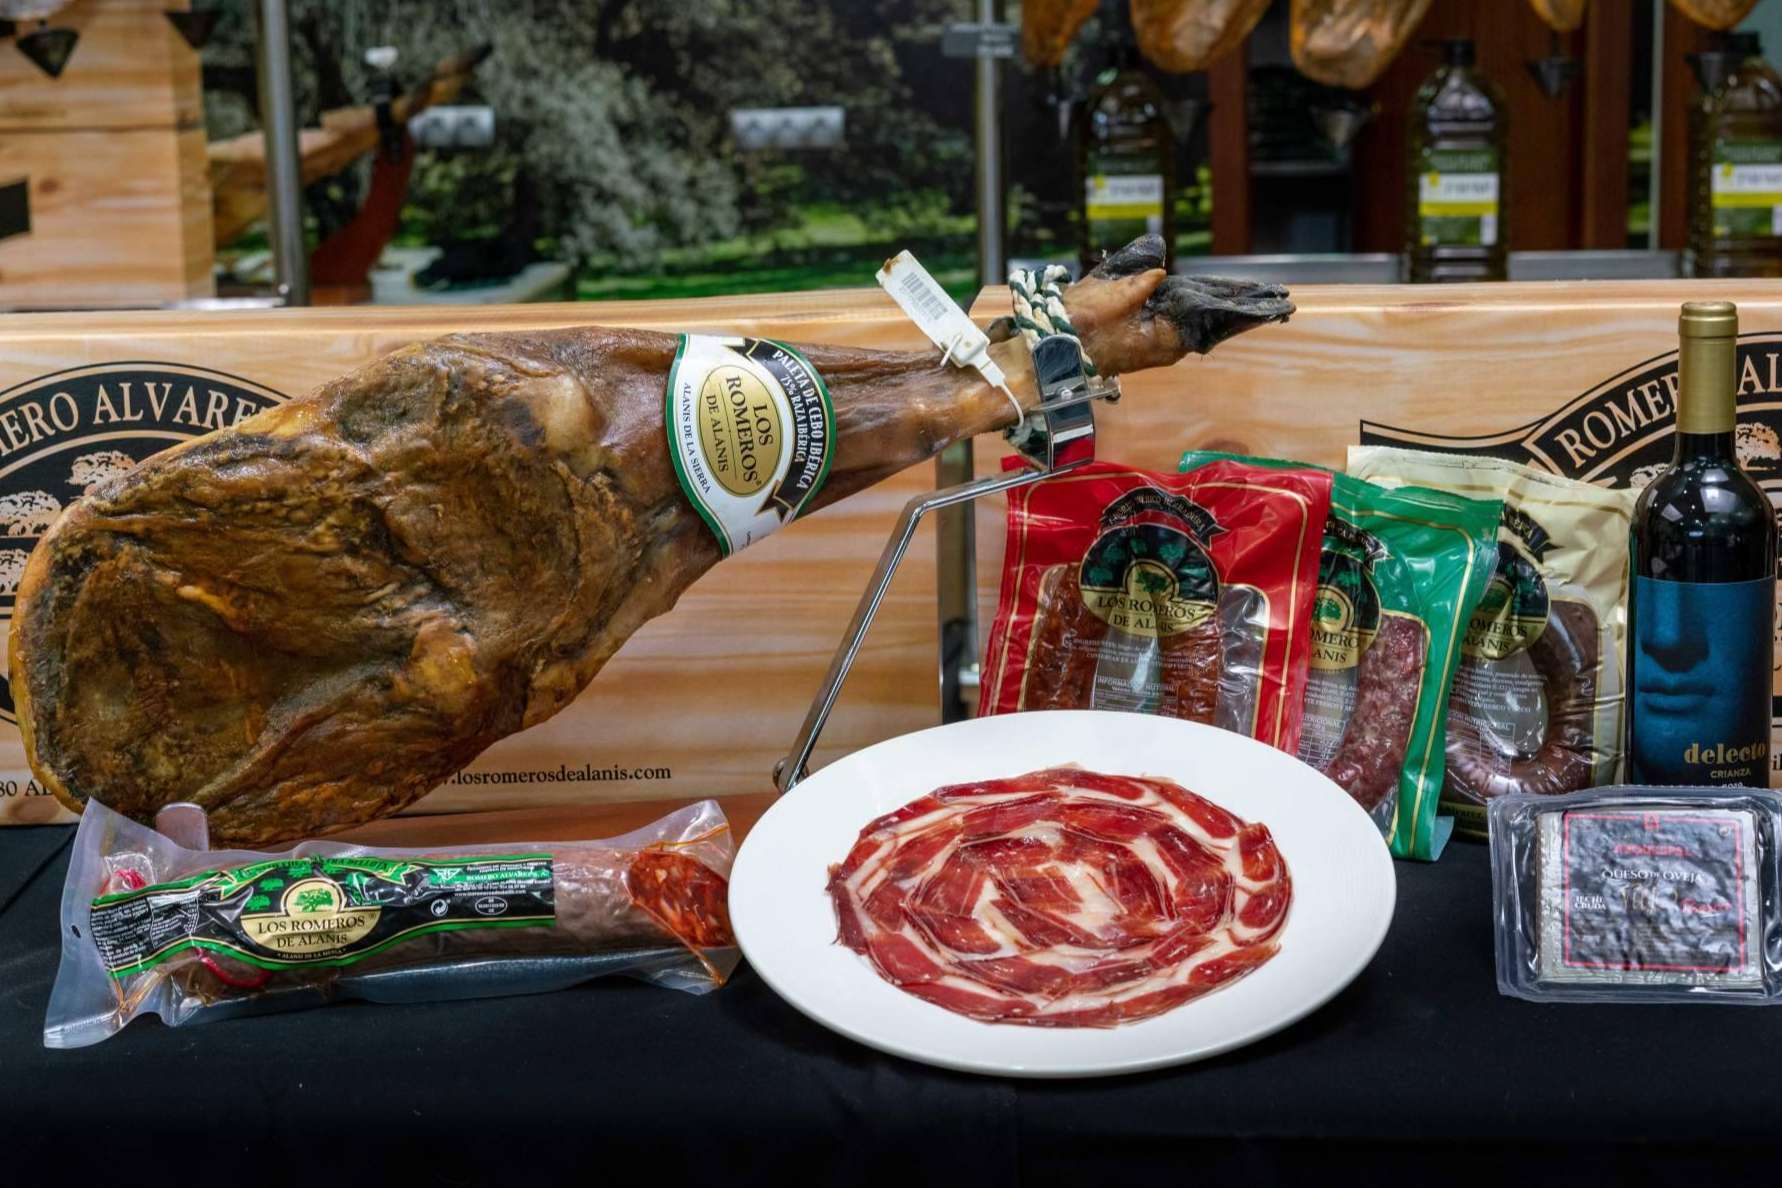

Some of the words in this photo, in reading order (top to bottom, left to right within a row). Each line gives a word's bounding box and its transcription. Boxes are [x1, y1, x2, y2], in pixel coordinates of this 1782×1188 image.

[772, 349, 807, 392] PALETA
[705, 394, 718, 415] DE
[779, 374, 796, 397] 75%
[790, 395, 806, 422] RAZA
[803, 385, 819, 404] DE
[93, 382, 268, 431] ALVARE
[726, 375, 758, 483] ROMEROS
[752, 403, 774, 447] LOS
[808, 400, 825, 439] CEBO
[682, 426, 692, 439] DE
[685, 439, 694, 457] LA
[710, 417, 729, 473] ALANIS
[690, 457, 711, 495] SIERRA
[1098, 597, 1125, 609] LOS
[1113, 614, 1129, 627] DE
[1684, 742, 1765, 764] delecto
[443, 764, 671, 785] .losromerosdealanis.com
[1711, 769, 1751, 779] CRIANZA
[1601, 866, 1648, 880] QUESO
[1662, 873, 1704, 883] OVEJA
[258, 920, 286, 934] LOS
[291, 915, 365, 932] ROMEROS
[276, 936, 295, 948] DE
[298, 933, 348, 947] ALANIS
